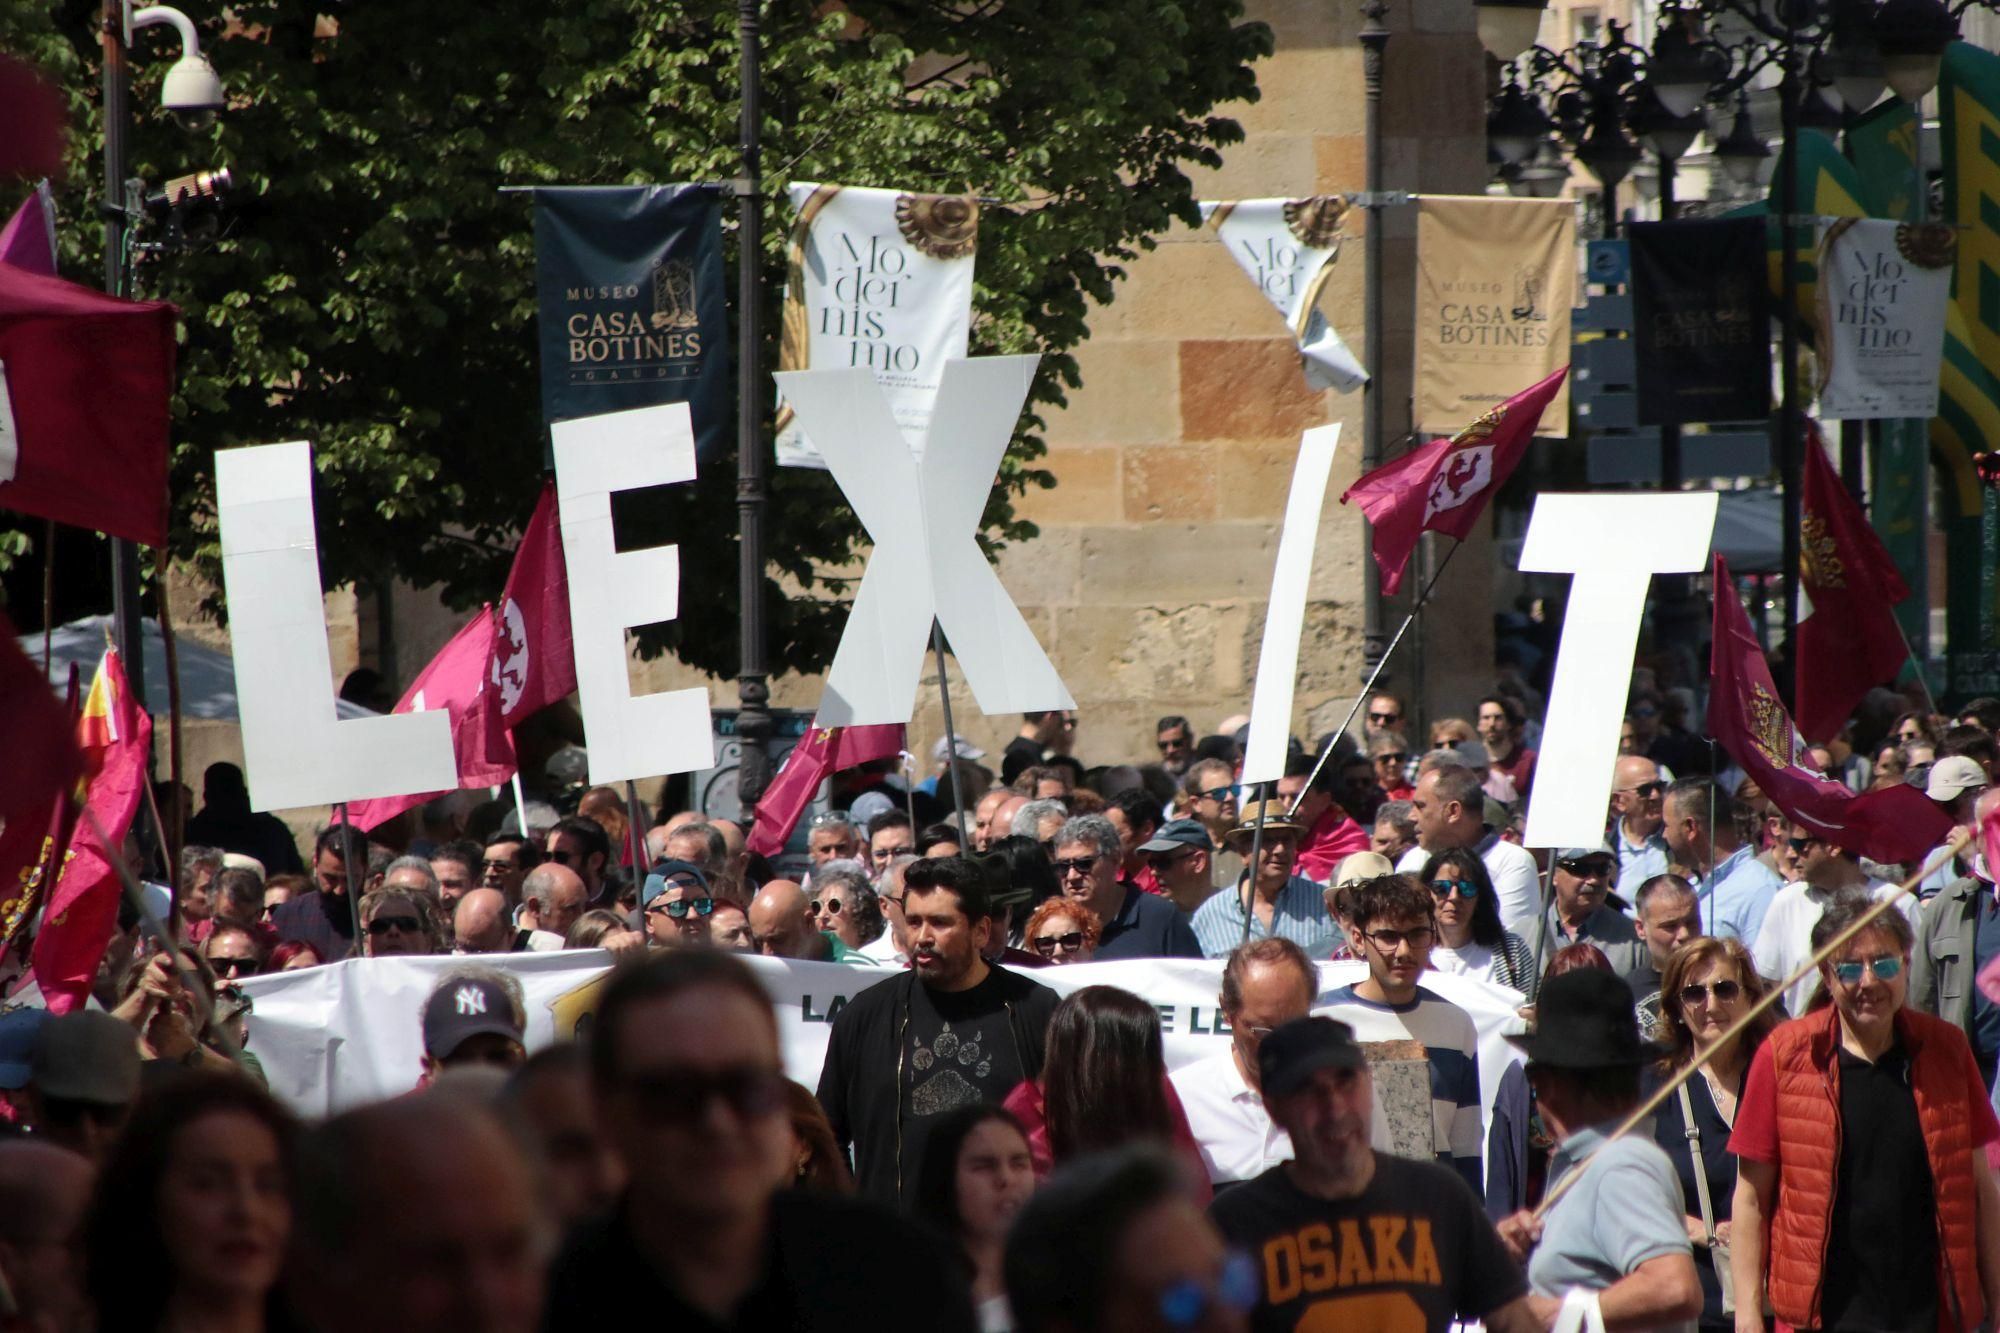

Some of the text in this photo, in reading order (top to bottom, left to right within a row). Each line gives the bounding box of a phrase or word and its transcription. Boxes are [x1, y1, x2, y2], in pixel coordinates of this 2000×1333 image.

[838, 232, 906, 275] Mo
[1853, 249, 1904, 282] Mo
[566, 284, 640, 302] MUSEO
[835, 266, 911, 308] der
[1441, 281, 1503, 295] MUSEO
[1849, 272, 1908, 306] der
[567, 311, 646, 339] CASA
[821, 304, 885, 339] nis
[1439, 303, 1506, 324] CASA
[1838, 302, 1887, 326] nis
[568, 332, 702, 364] BOTINES
[1439, 324, 1549, 347] BOTINES
[1857, 325, 1912, 349] mo
[849, 340, 920, 373] mo
[455, 984, 487, 1016] NY
[1189, 1006, 1234, 1036] LE
[1263, 1215, 1443, 1305] OSAKA
